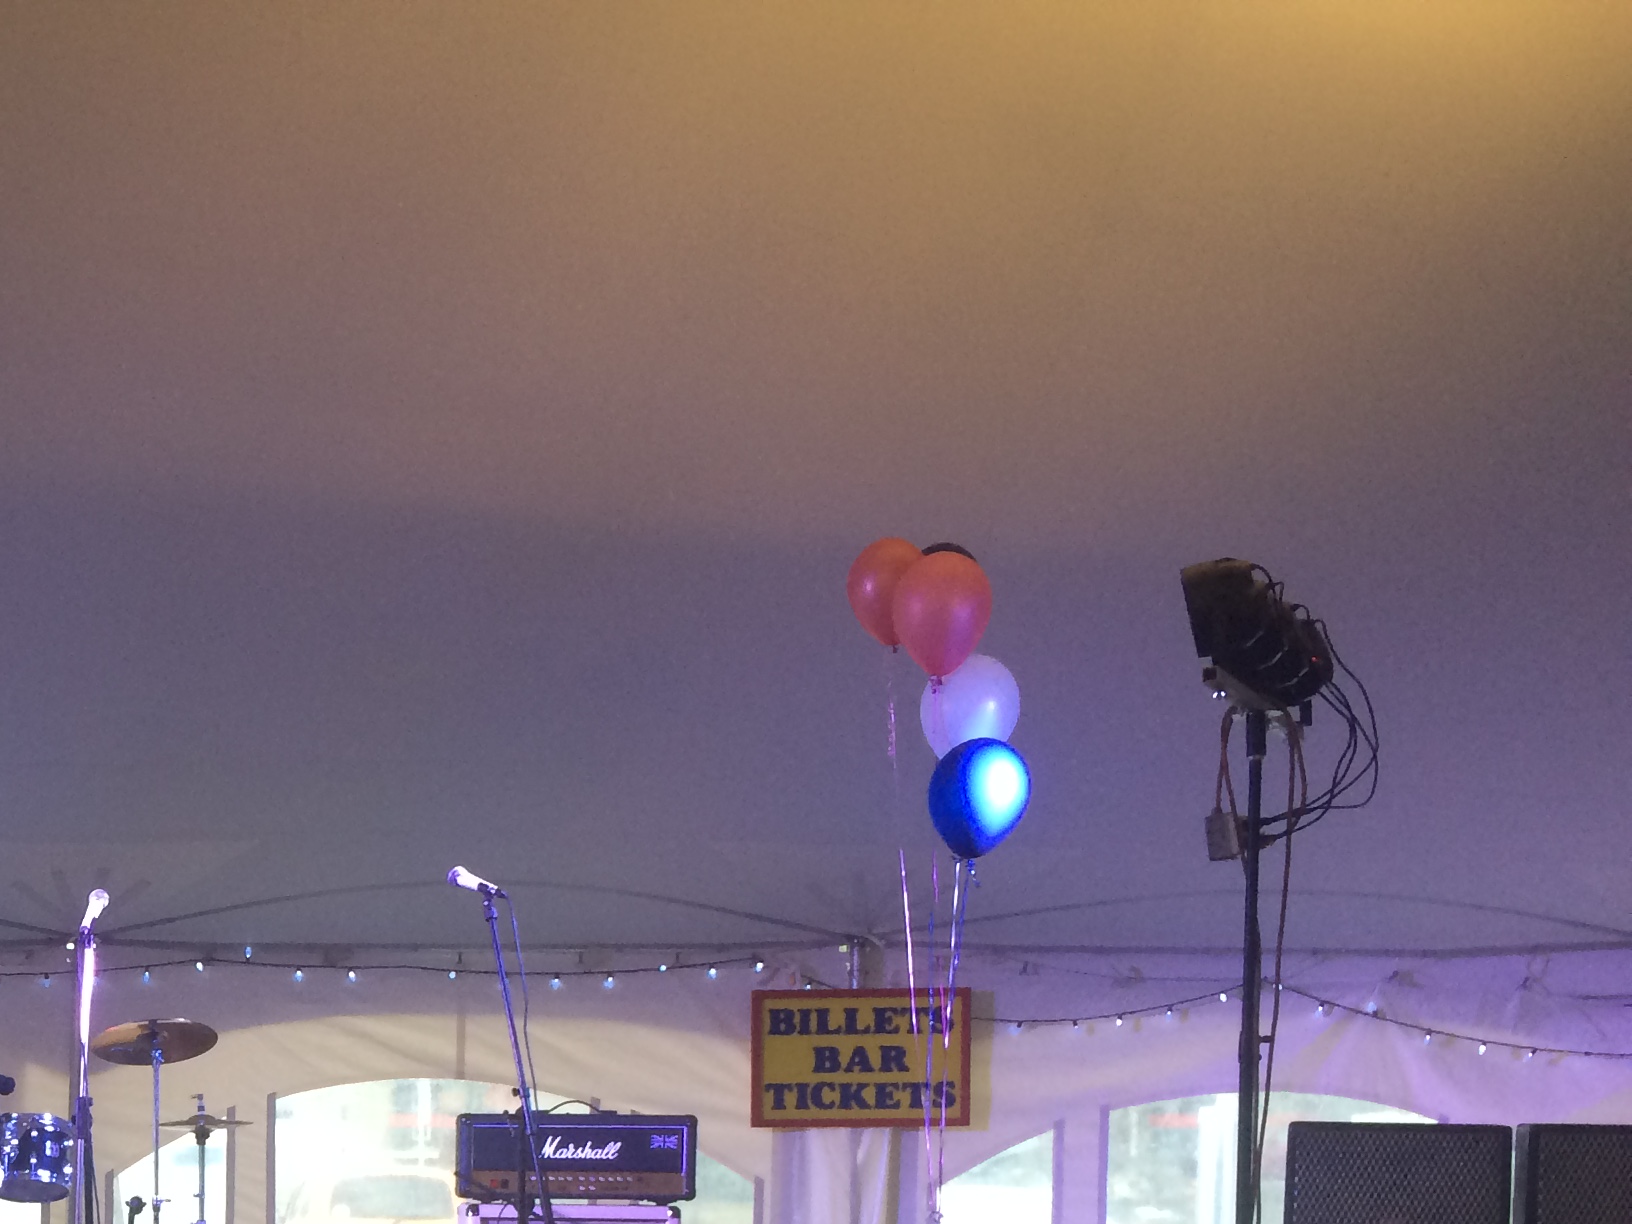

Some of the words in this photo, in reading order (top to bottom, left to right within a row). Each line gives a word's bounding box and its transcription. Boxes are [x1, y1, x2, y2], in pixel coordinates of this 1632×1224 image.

[768, 1007, 954, 1036] BILLETS
[812, 1045, 910, 1073] BAR
[765, 1081, 956, 1110] TICKETS
[540, 1136, 621, 1159] Marshall
